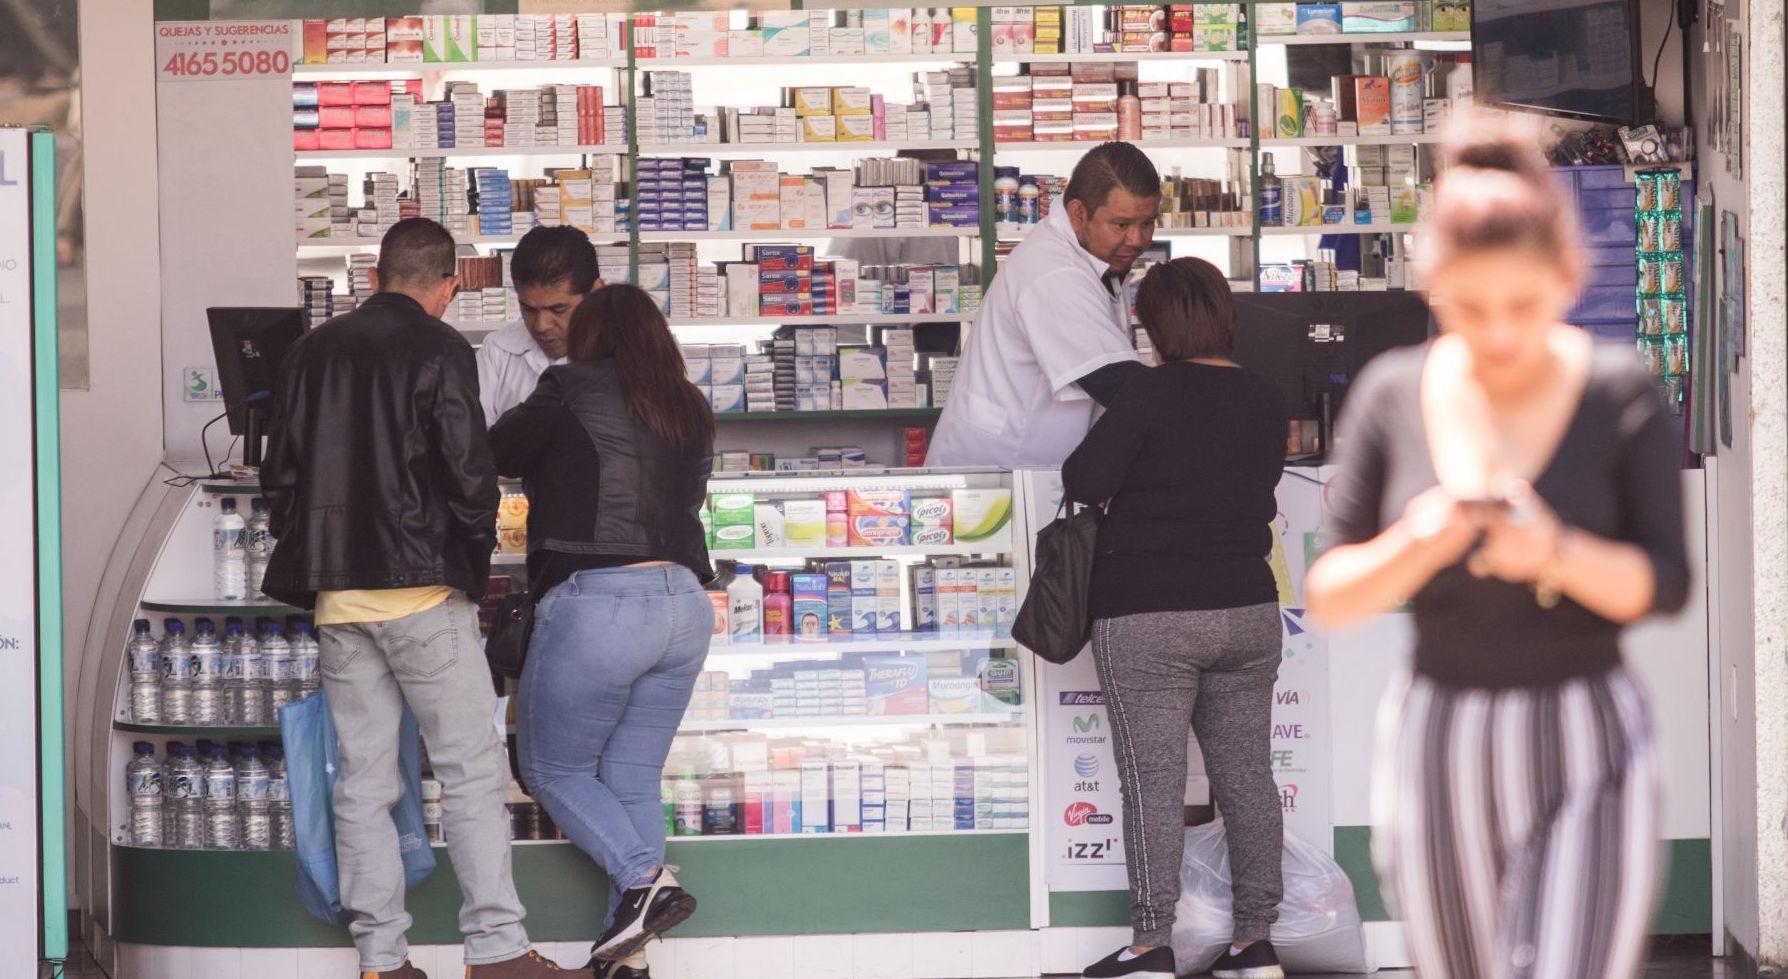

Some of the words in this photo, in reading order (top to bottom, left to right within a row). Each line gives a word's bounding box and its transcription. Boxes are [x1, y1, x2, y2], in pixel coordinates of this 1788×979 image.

[160, 27, 202, 37] QUEJAS
[205, 26, 213, 36] Y
[214, 24, 290, 36] SUGERENCIAS
[163, 51, 219, 76] 4165
[221, 50, 290, 76] 5080
[1075, 694, 1105, 704] telce
[1066, 736, 1107, 745] movistar
[1074, 780, 1100, 792] at&t
